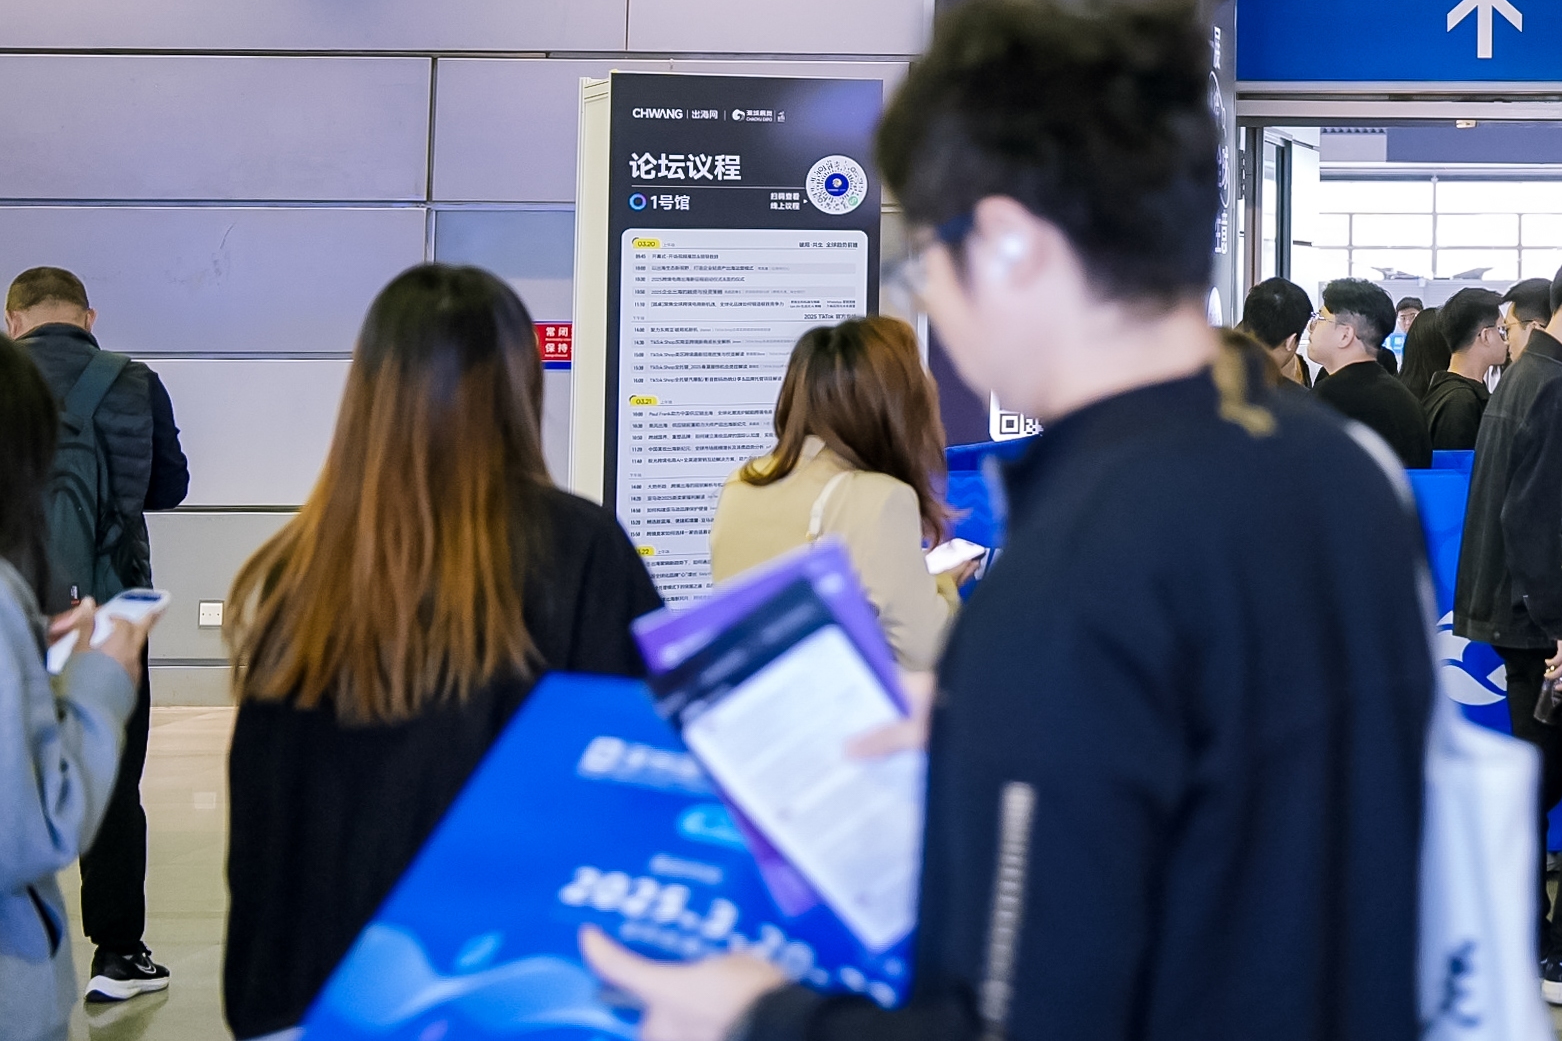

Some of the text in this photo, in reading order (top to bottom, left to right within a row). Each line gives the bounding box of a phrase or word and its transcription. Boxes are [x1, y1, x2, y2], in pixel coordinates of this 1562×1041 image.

[632, 108, 719, 120] CHWANG 出海网
[629, 152, 742, 181] 论坛议程
[650, 194, 691, 211] 1号馆
[637, 240, 656, 248] 03.20
[545, 326, 569, 337] 常闭
[545, 343, 568, 353] 保持
